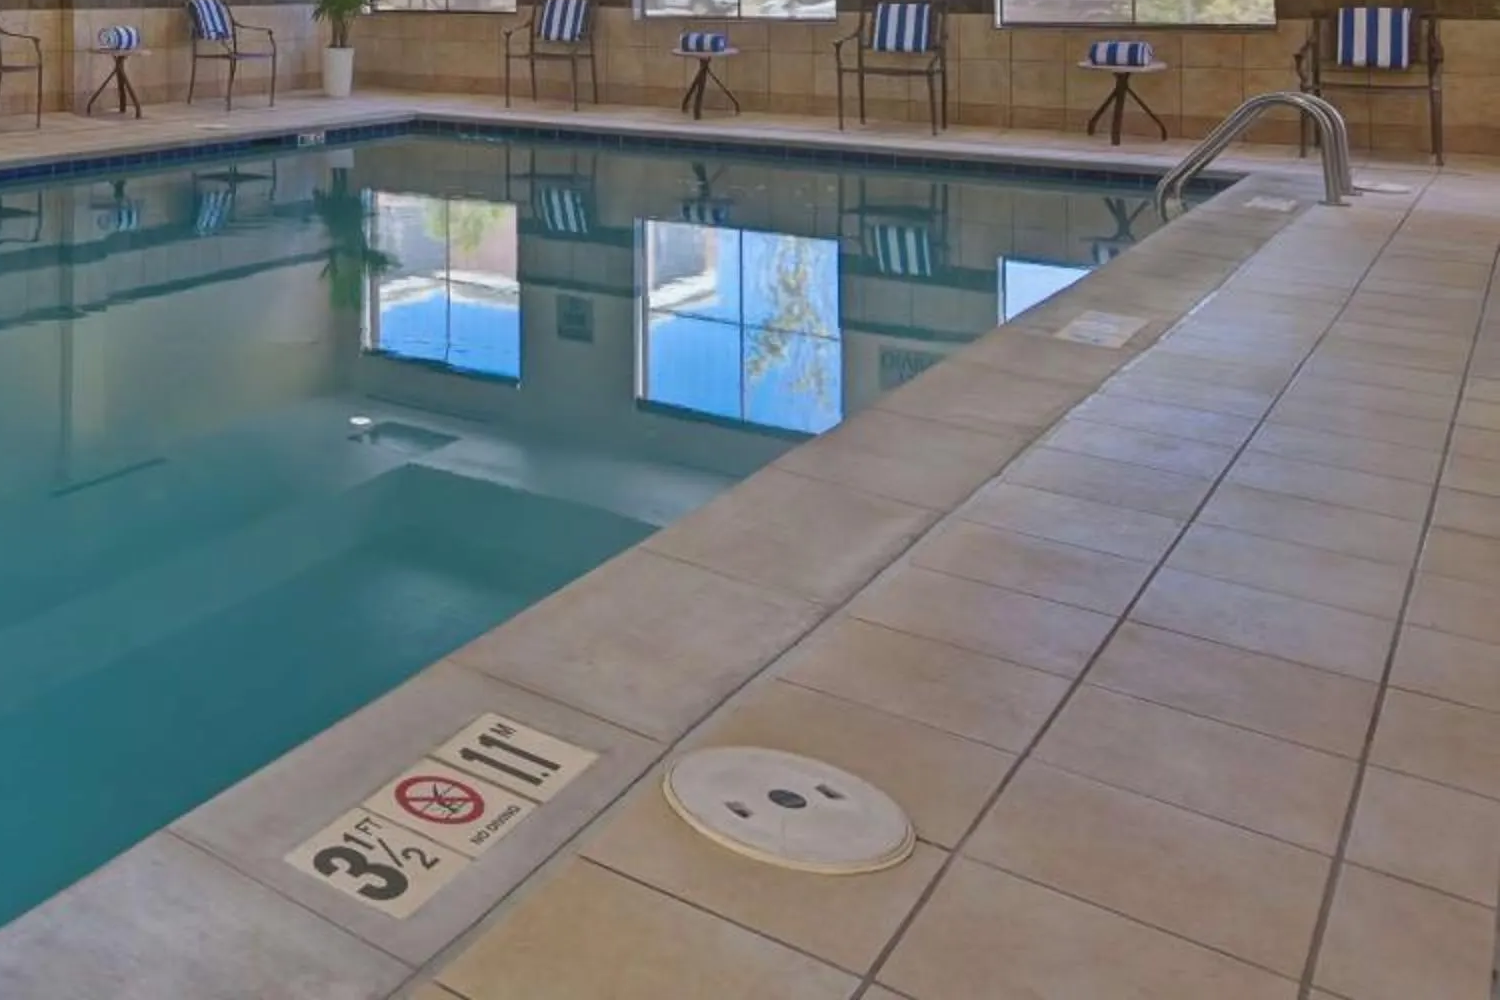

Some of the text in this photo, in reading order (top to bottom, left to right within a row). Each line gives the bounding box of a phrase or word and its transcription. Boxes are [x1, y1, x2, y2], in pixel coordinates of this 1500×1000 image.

[459, 733, 561, 786] 1.1
[470, 804, 521, 845] NO DIVING
